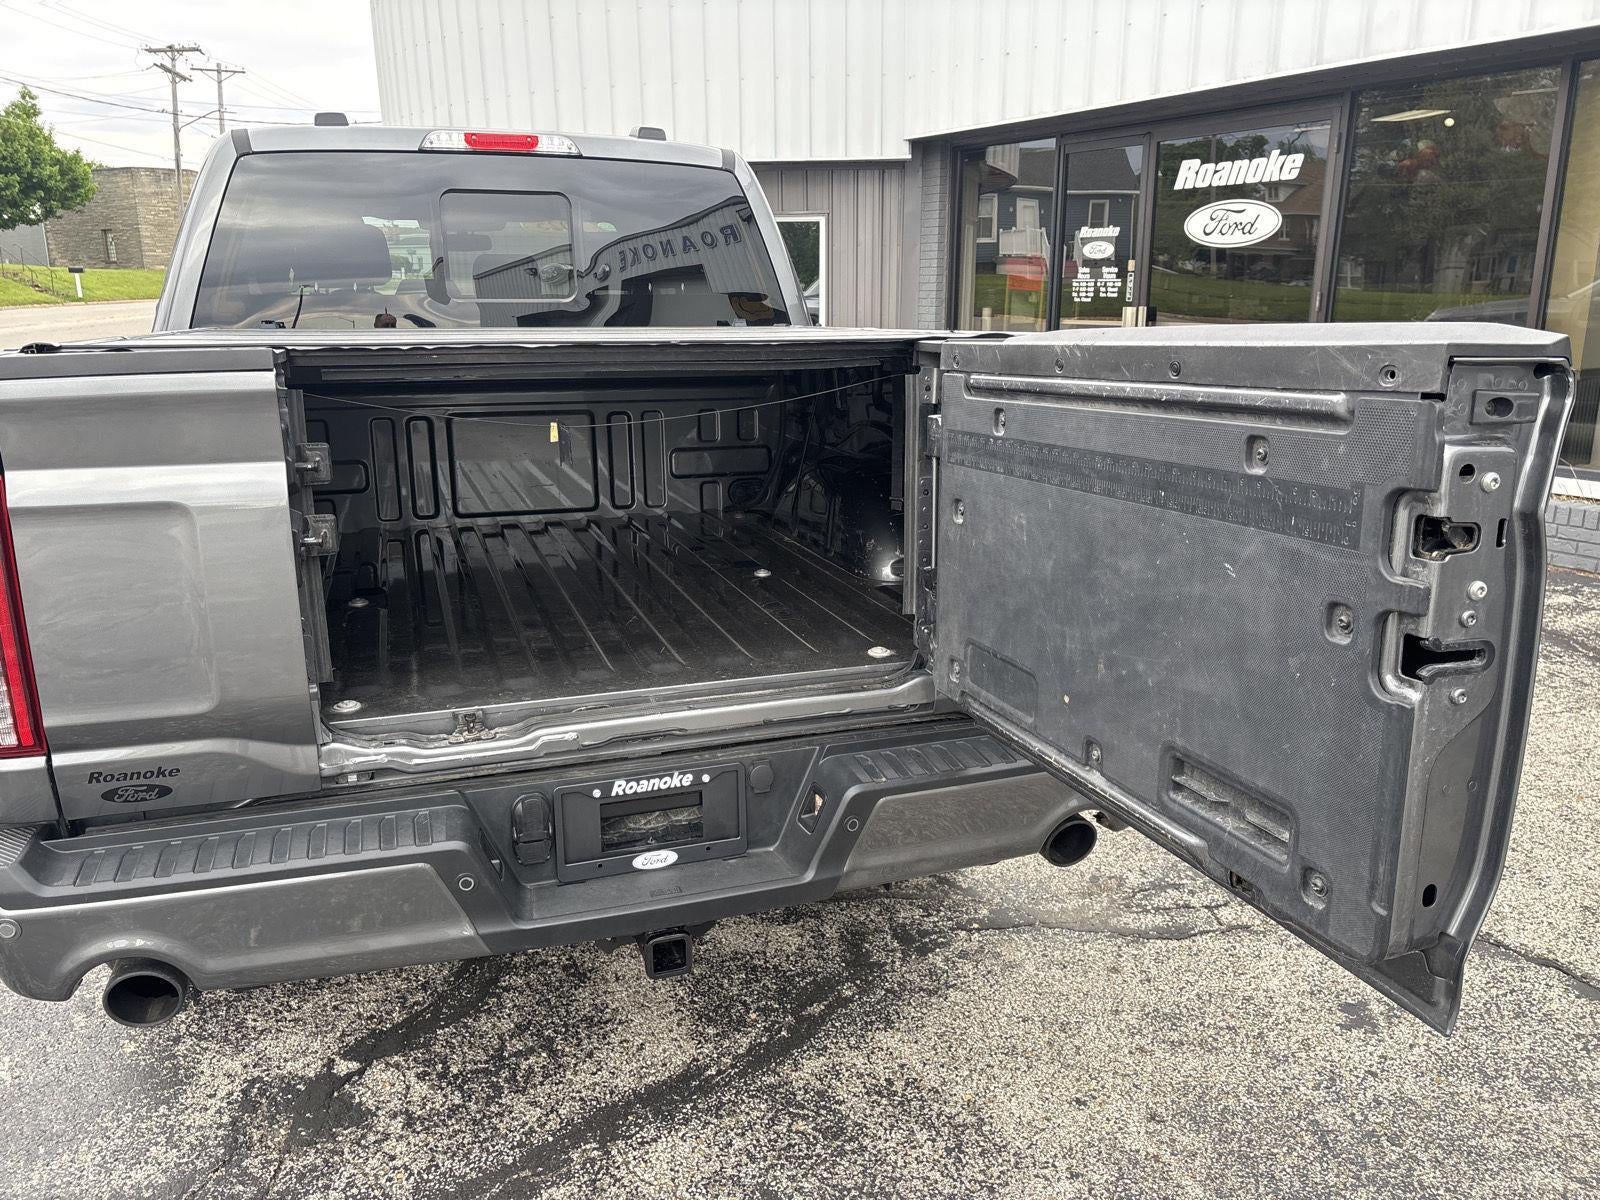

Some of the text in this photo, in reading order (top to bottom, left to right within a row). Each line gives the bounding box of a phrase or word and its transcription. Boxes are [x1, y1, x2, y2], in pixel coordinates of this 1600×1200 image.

[1173, 149, 1305, 191] Roanoke
[1080, 225, 1120, 237] Roanoke
[1202, 208, 1260, 237] Ford
[87, 766, 181, 784] Roanoke
[611, 771, 694, 797] Roanoke
[113, 786, 160, 803] Ford
